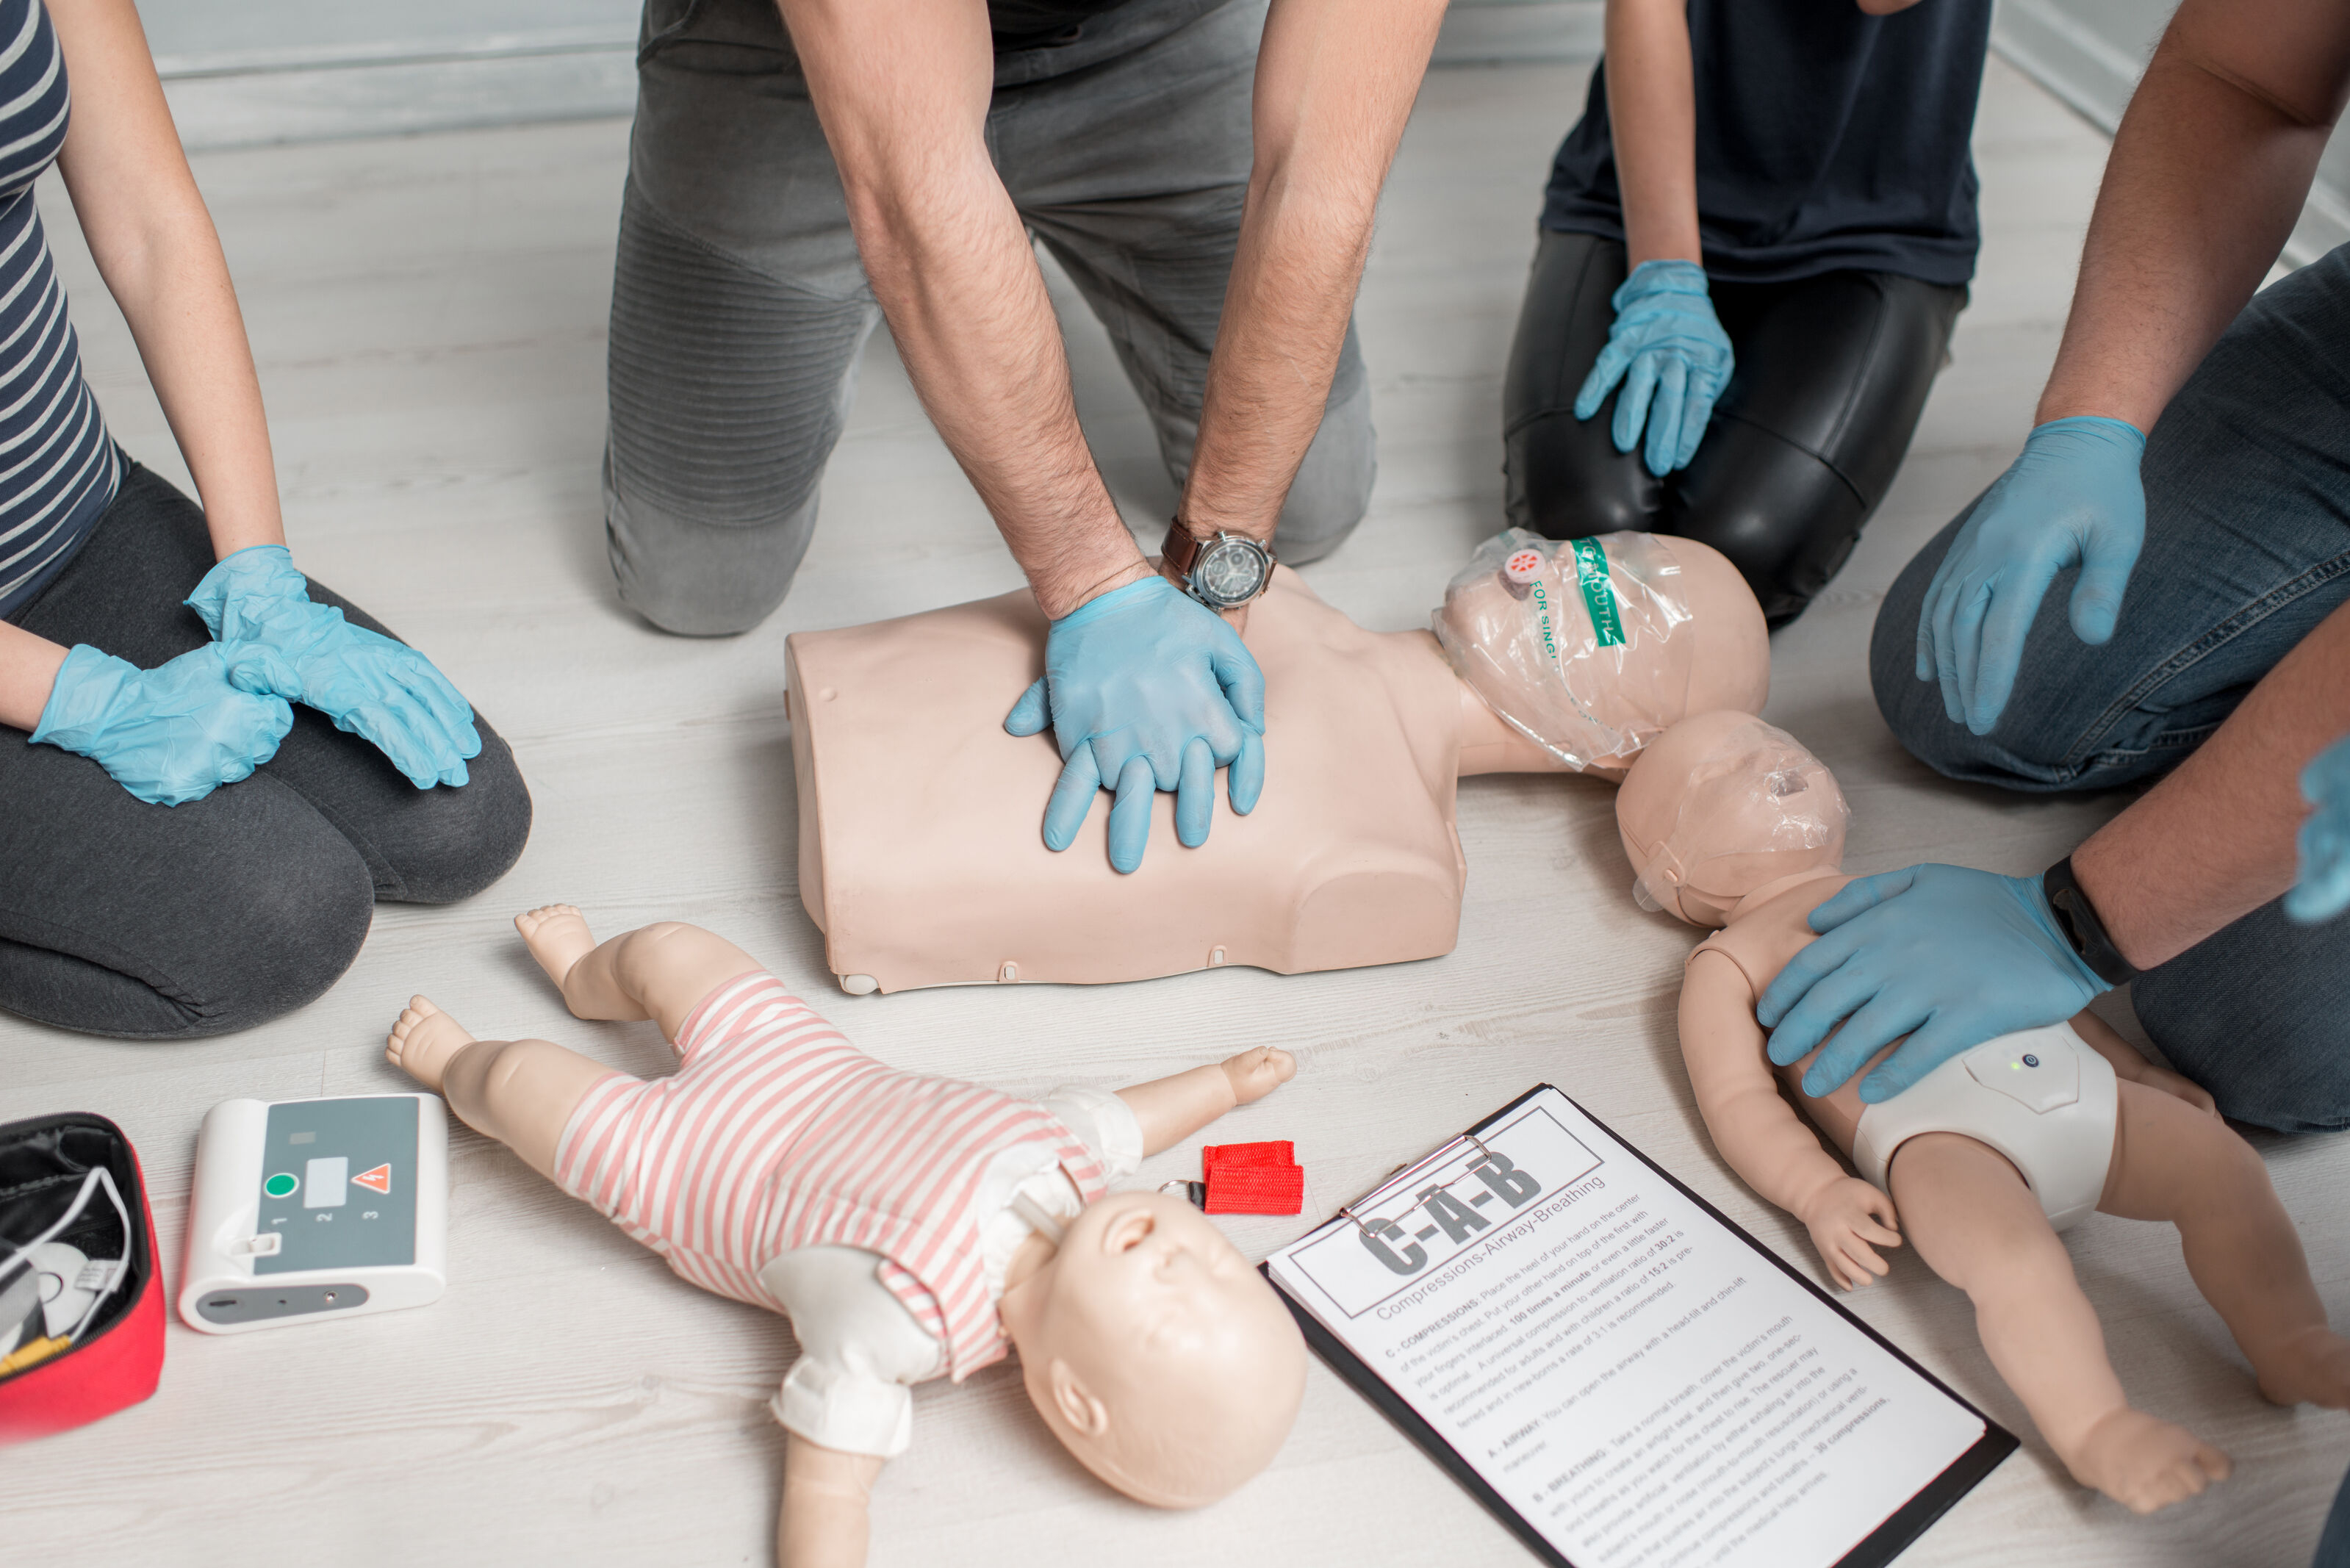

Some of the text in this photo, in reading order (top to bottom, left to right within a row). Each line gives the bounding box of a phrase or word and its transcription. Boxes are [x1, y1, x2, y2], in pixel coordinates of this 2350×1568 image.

[1529, 580, 1548, 611] FOR
[271, 1211, 378, 1225] 1 2 3
[1359, 1151, 1542, 1276] C-A-B
[1567, 1226, 1589, 1242] hand
[1589, 1220, 1601, 1229] on
[1600, 1211, 1615, 1221] the
[1615, 1194, 1639, 1212] center
[1600, 1233, 1614, 1243] the
[1613, 1221, 1631, 1234] first
[1630, 1211, 1647, 1223] with
[1376, 1176, 1606, 1320] Compressions-Airway-Breathing
[1627, 1234, 1645, 1247] little
[1644, 1218, 1667, 1234] faster
